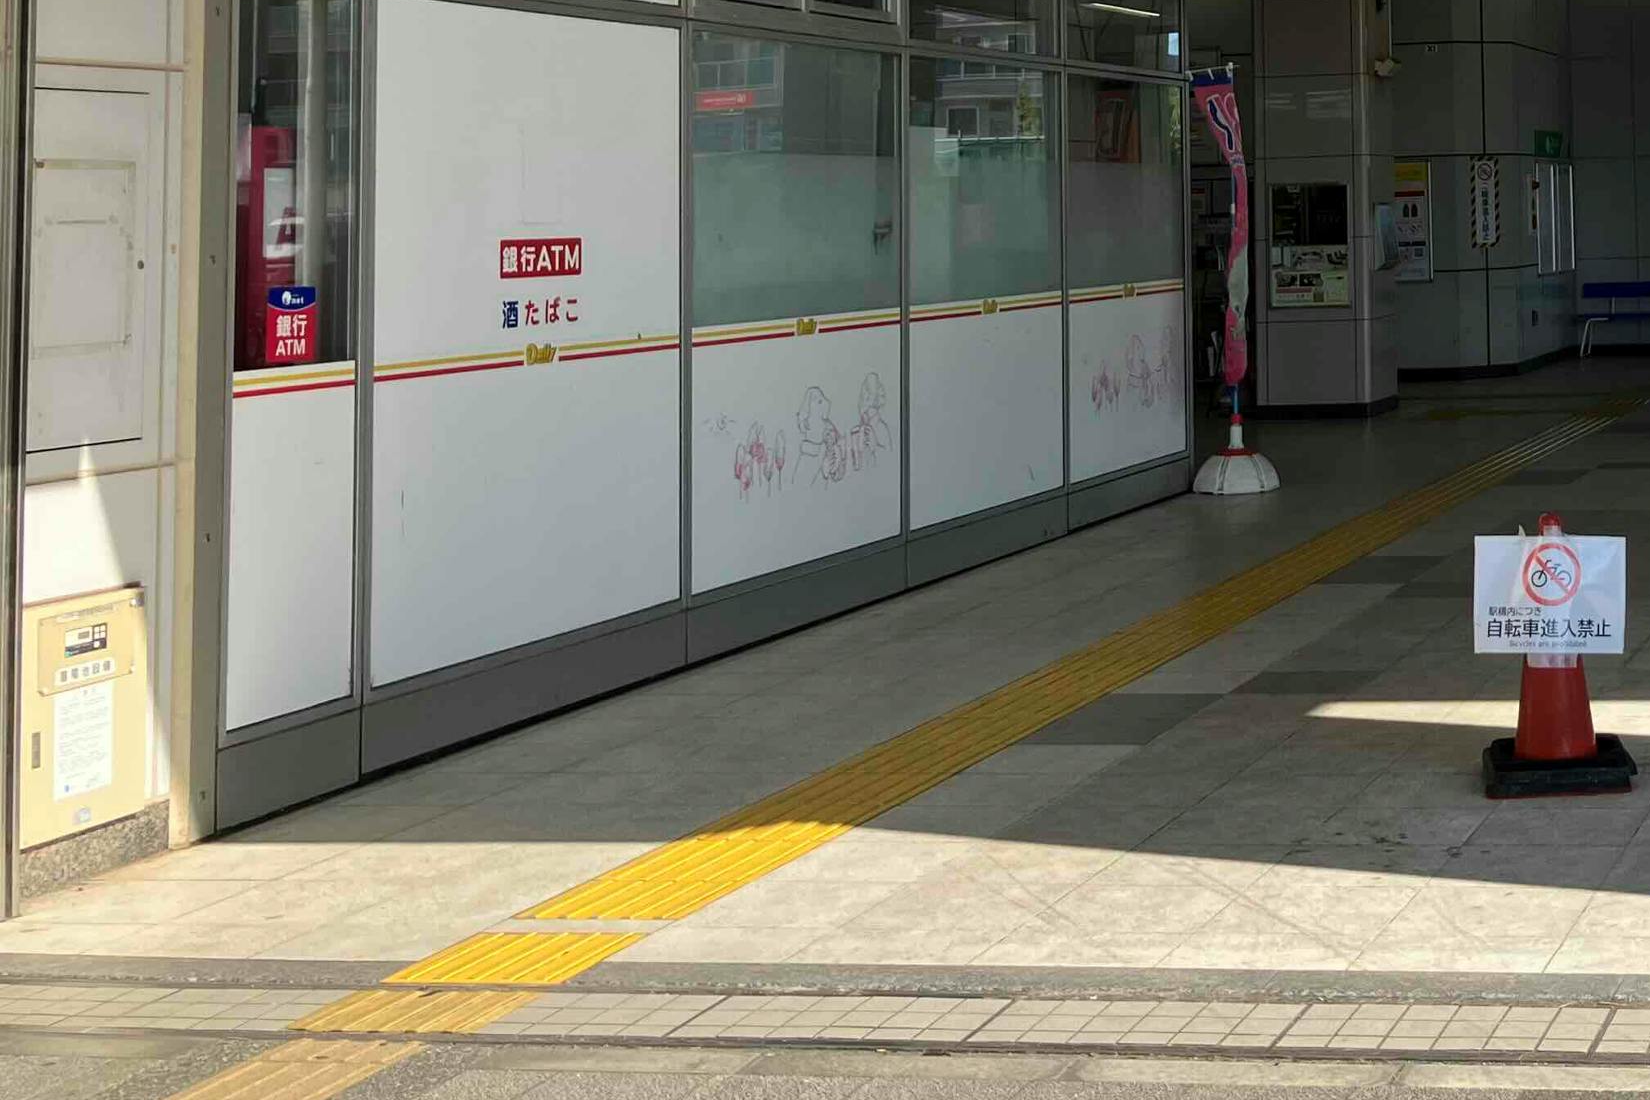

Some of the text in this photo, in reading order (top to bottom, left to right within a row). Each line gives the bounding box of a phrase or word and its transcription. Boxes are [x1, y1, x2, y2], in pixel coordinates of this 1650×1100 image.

[502, 244, 580, 273] 銀行ATM
[275, 313, 308, 338] 銀行
[275, 337, 306, 357] ATM
[1488, 605, 1543, 617] 駅構内につき
[1486, 618, 1612, 639] 自転車進入禁止
